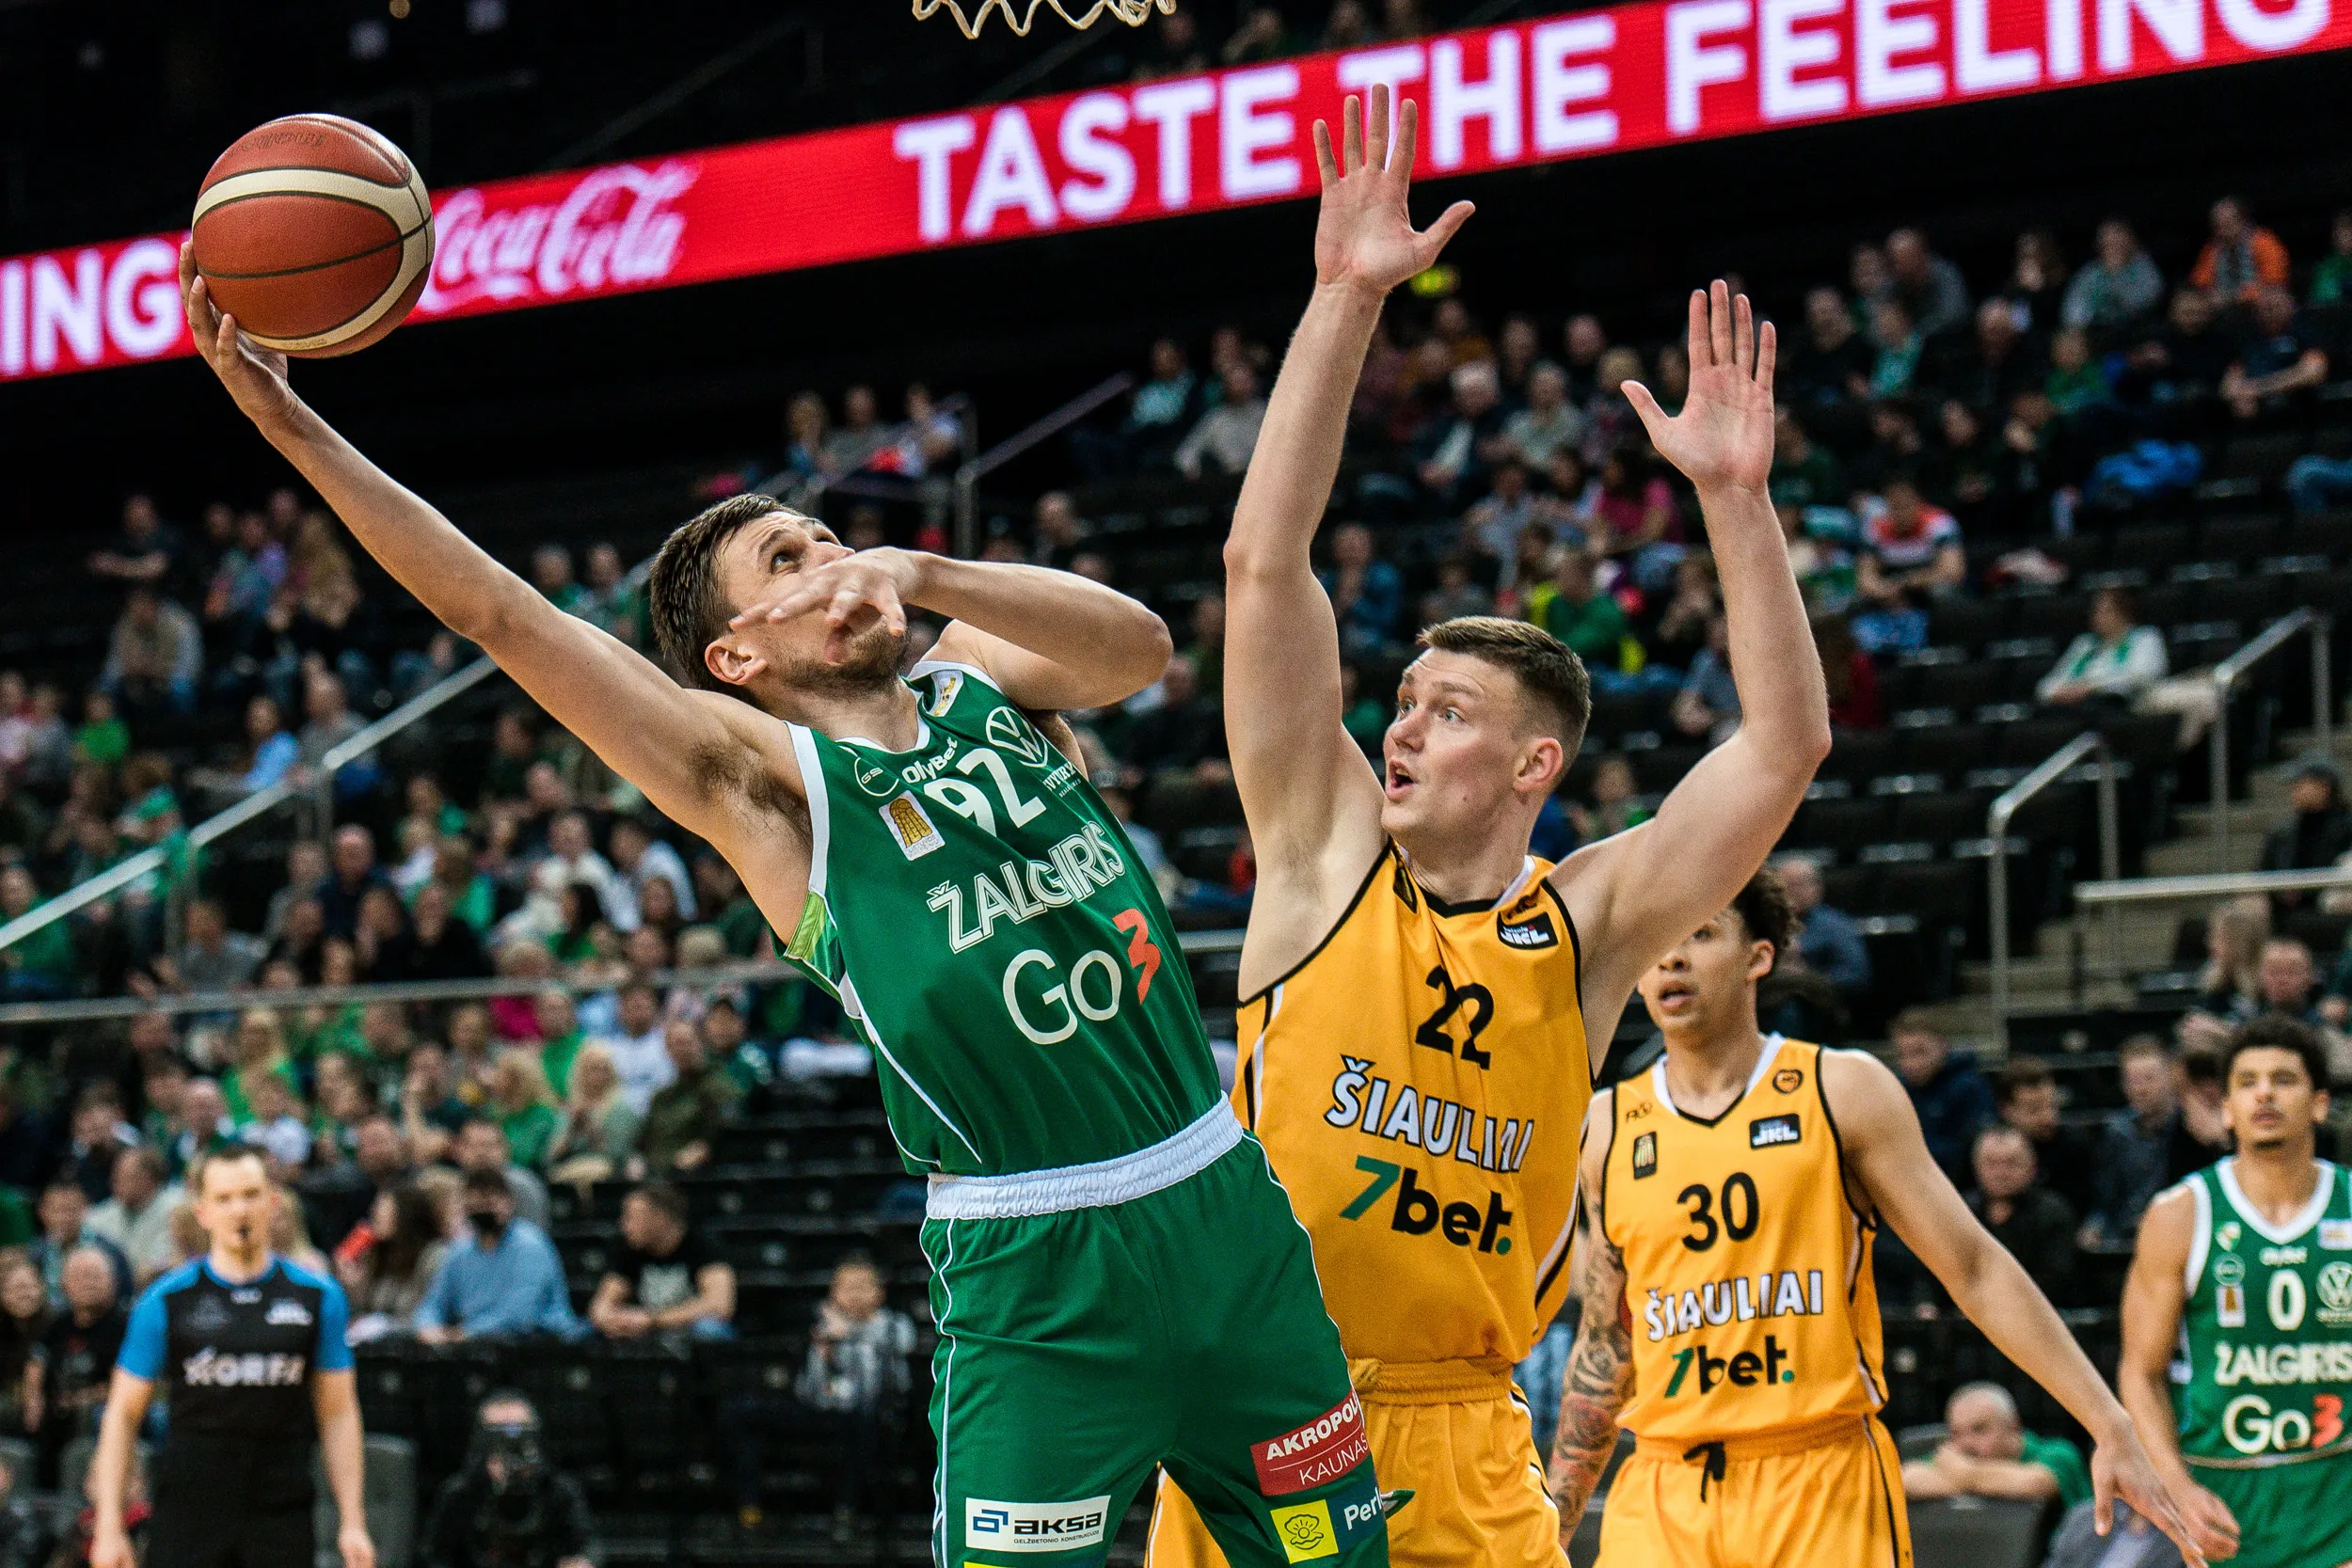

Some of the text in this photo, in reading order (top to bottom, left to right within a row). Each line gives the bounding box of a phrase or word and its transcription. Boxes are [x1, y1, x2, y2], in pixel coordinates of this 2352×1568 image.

[893, 64, 1303, 243] TASTE
[1336, 14, 1619, 173] THE
[1, 237, 183, 375] ING
[901, 736, 958, 784] OlyBet
[923, 748, 1047, 838] 92
[927, 821, 1126, 953] ŽALGIRIS
[1002, 908, 1161, 1045] Go3
[1415, 965, 1495, 1069] 22
[1339, 1154, 1513, 1255] 7bet.
[1677, 1172, 1760, 1253] 30
[1644, 1269, 1824, 1342] ŠIAULIAI
[2266, 1270, 2306, 1331] 0
[1664, 1335, 1795, 1399] 7bet.
[1299, 1432, 1369, 1485] KAUNAS
[2222, 1393, 2344, 1454] Go3
[1014, 1512, 1102, 1535] aksa
